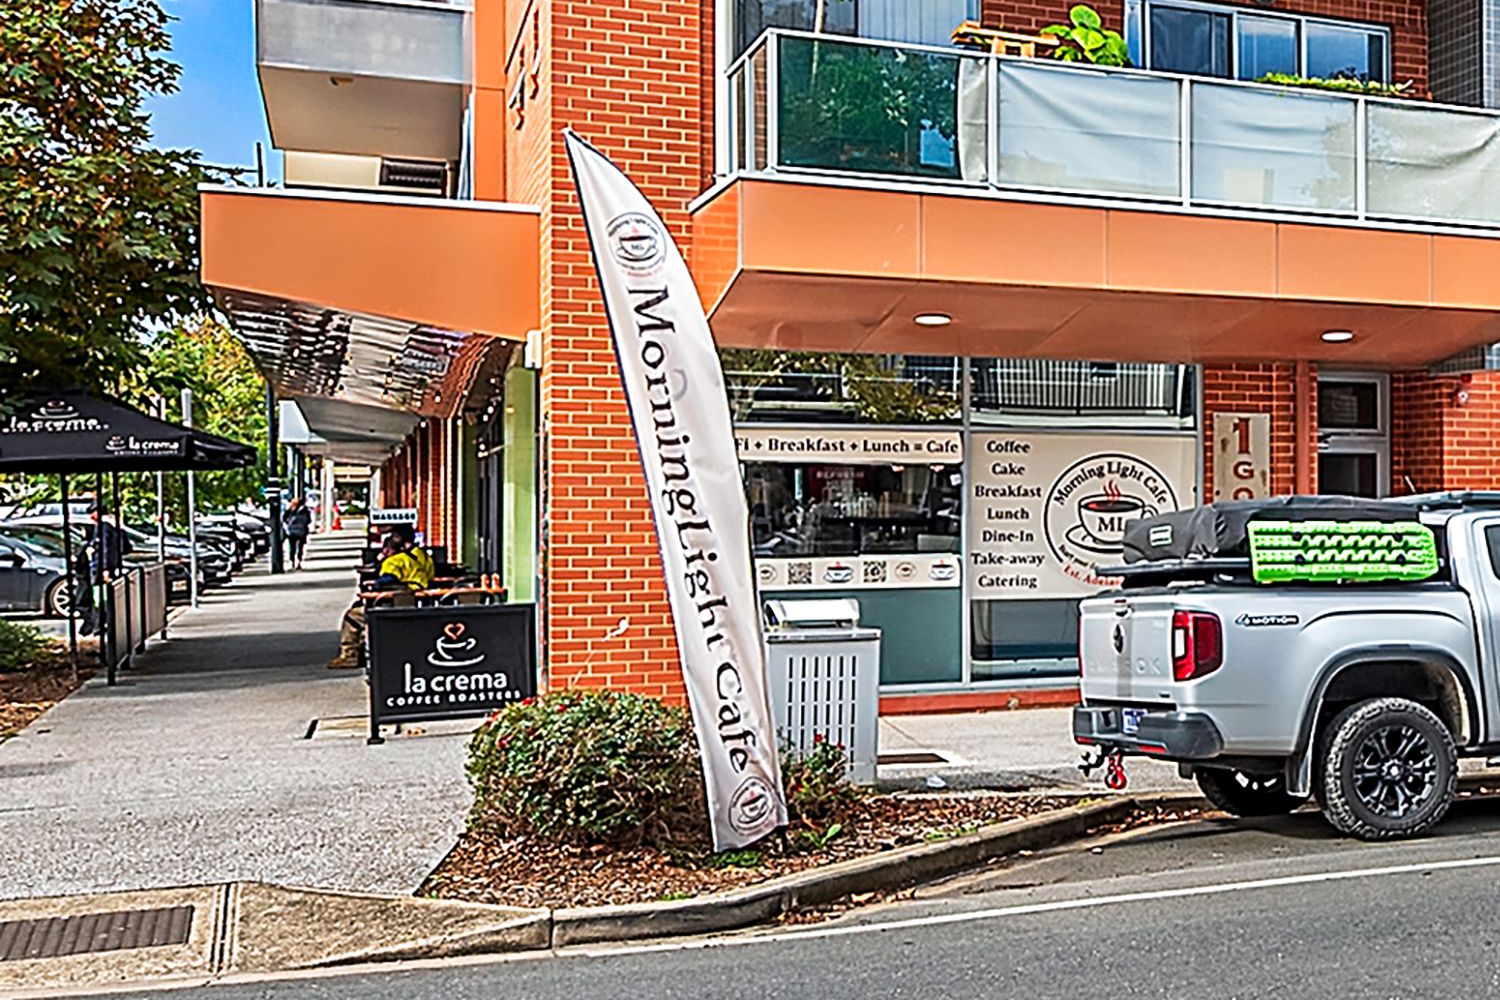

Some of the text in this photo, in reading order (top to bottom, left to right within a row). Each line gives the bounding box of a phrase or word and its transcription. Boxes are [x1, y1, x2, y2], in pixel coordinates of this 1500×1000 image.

[129, 436, 179, 449] la crema
[1233, 418, 1250, 454] 1
[768, 438, 845, 451] Breakfast
[863, 439, 909, 452] Lunch
[926, 440, 958, 453] Cafe
[987, 440, 1030, 453] Coffee
[992, 463, 1025, 475] Cake
[1054, 461, 1168, 505] Morning Light Cafe
[975, 485, 1042, 498] Breakfast
[987, 508, 1030, 520] Lunch
[982, 530, 1034, 542] Dine-In
[971, 552, 1046, 567] Take-away
[978, 575, 1038, 589] Catering
[404, 662, 508, 694] la crema
[386, 689, 521, 707] COFFEE ROASTERS
[716, 662, 756, 774] Cafe
